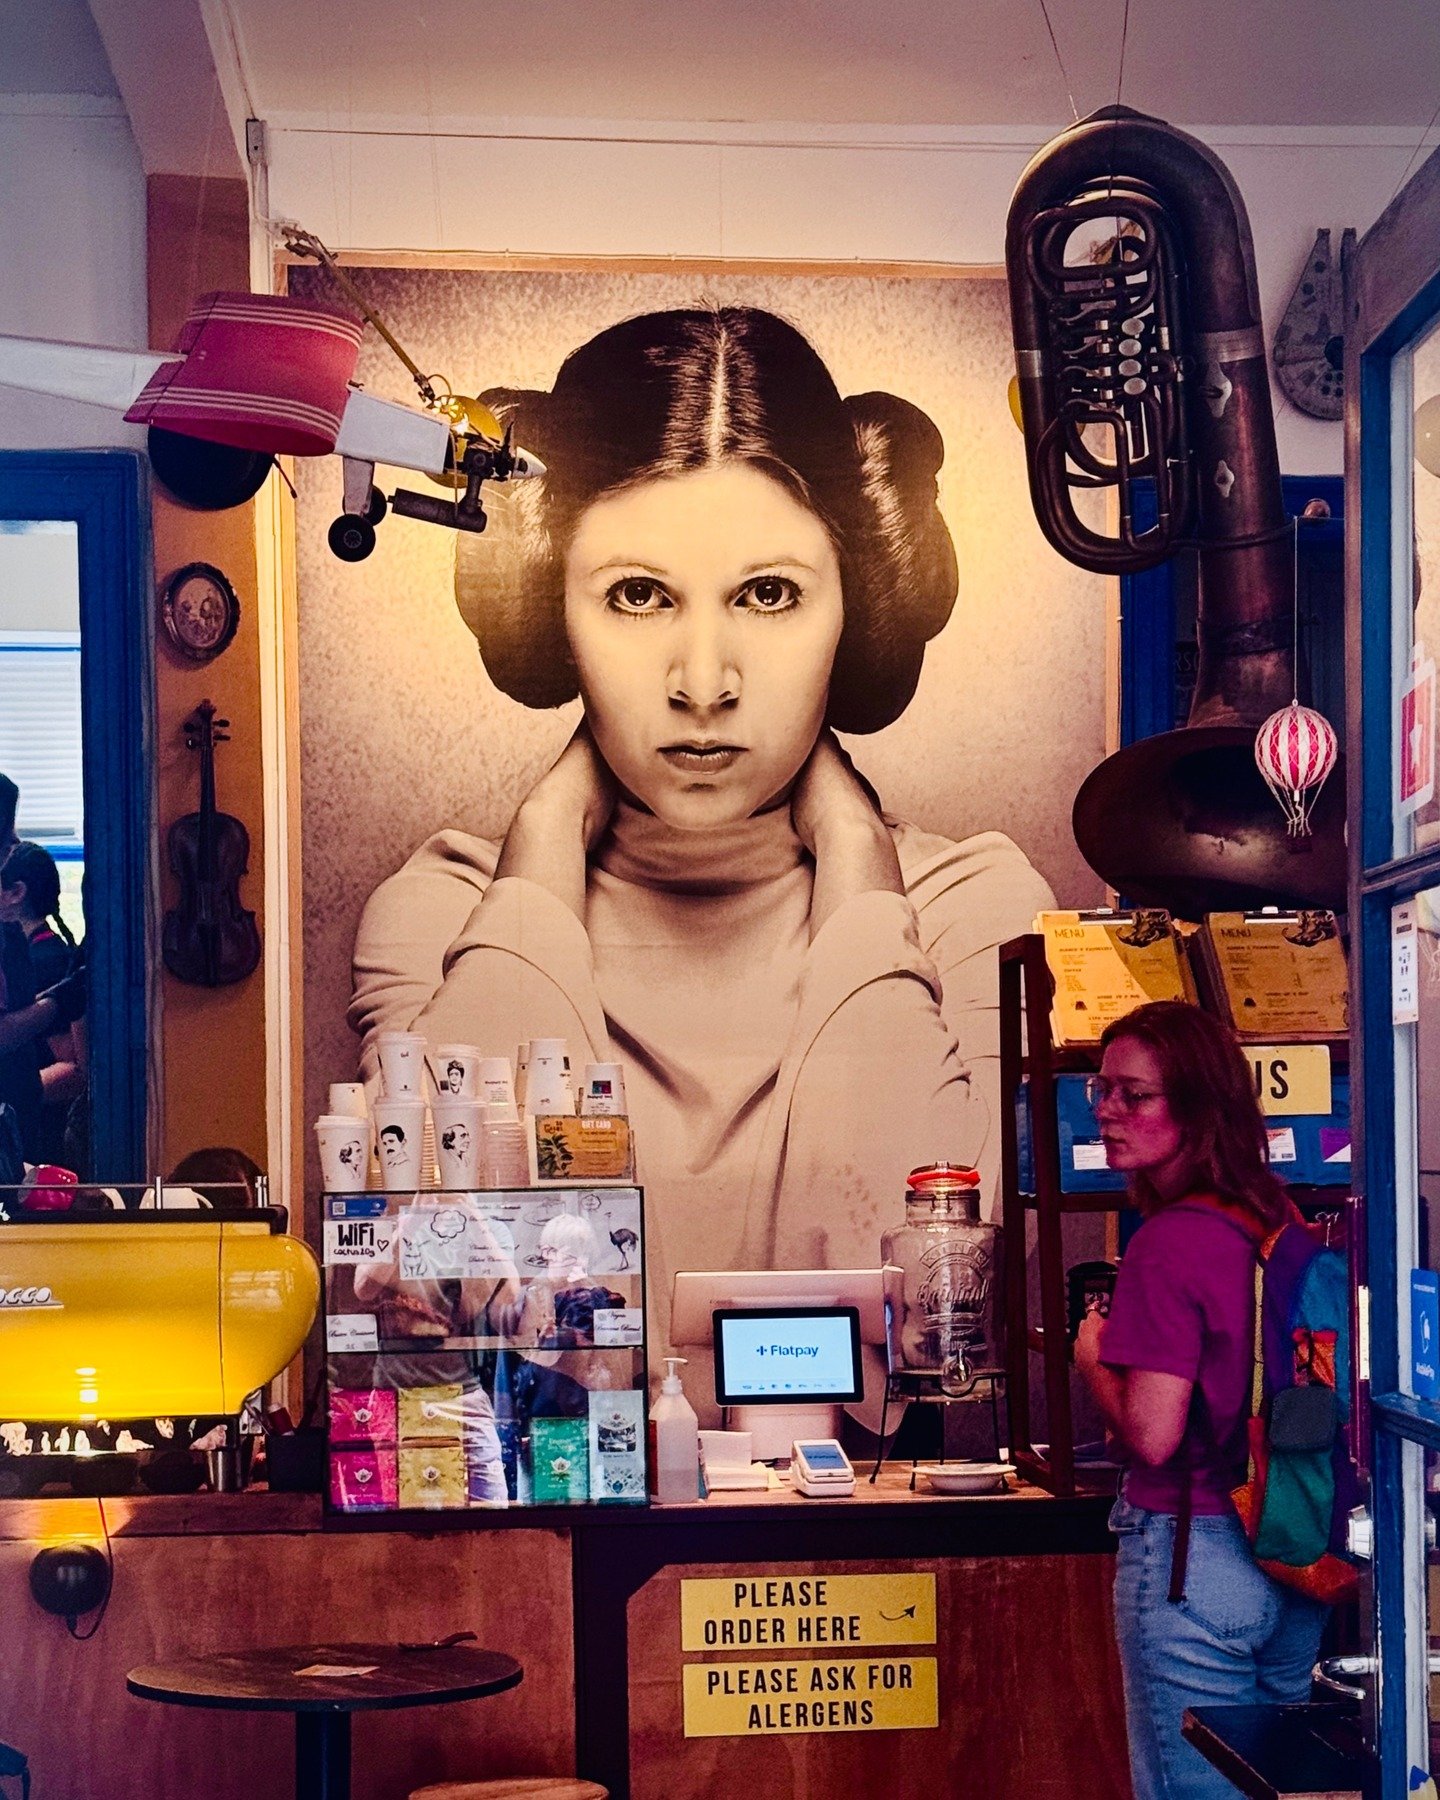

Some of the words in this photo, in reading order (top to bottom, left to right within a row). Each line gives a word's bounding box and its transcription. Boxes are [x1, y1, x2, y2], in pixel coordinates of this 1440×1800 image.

[1055, 929, 1085, 939] MENU
[1221, 928, 1252, 938] MENU
[770, 1344, 819, 1358] Flatpay
[734, 1581, 828, 1608] PLEASE
[704, 1618, 785, 1645] ORDER
[798, 1616, 861, 1642] HERE
[707, 1668, 798, 1695] PLEASE
[810, 1665, 856, 1692] ASK
[868, 1664, 912, 1689] FOR
[748, 1700, 874, 1729] ALERGENS
